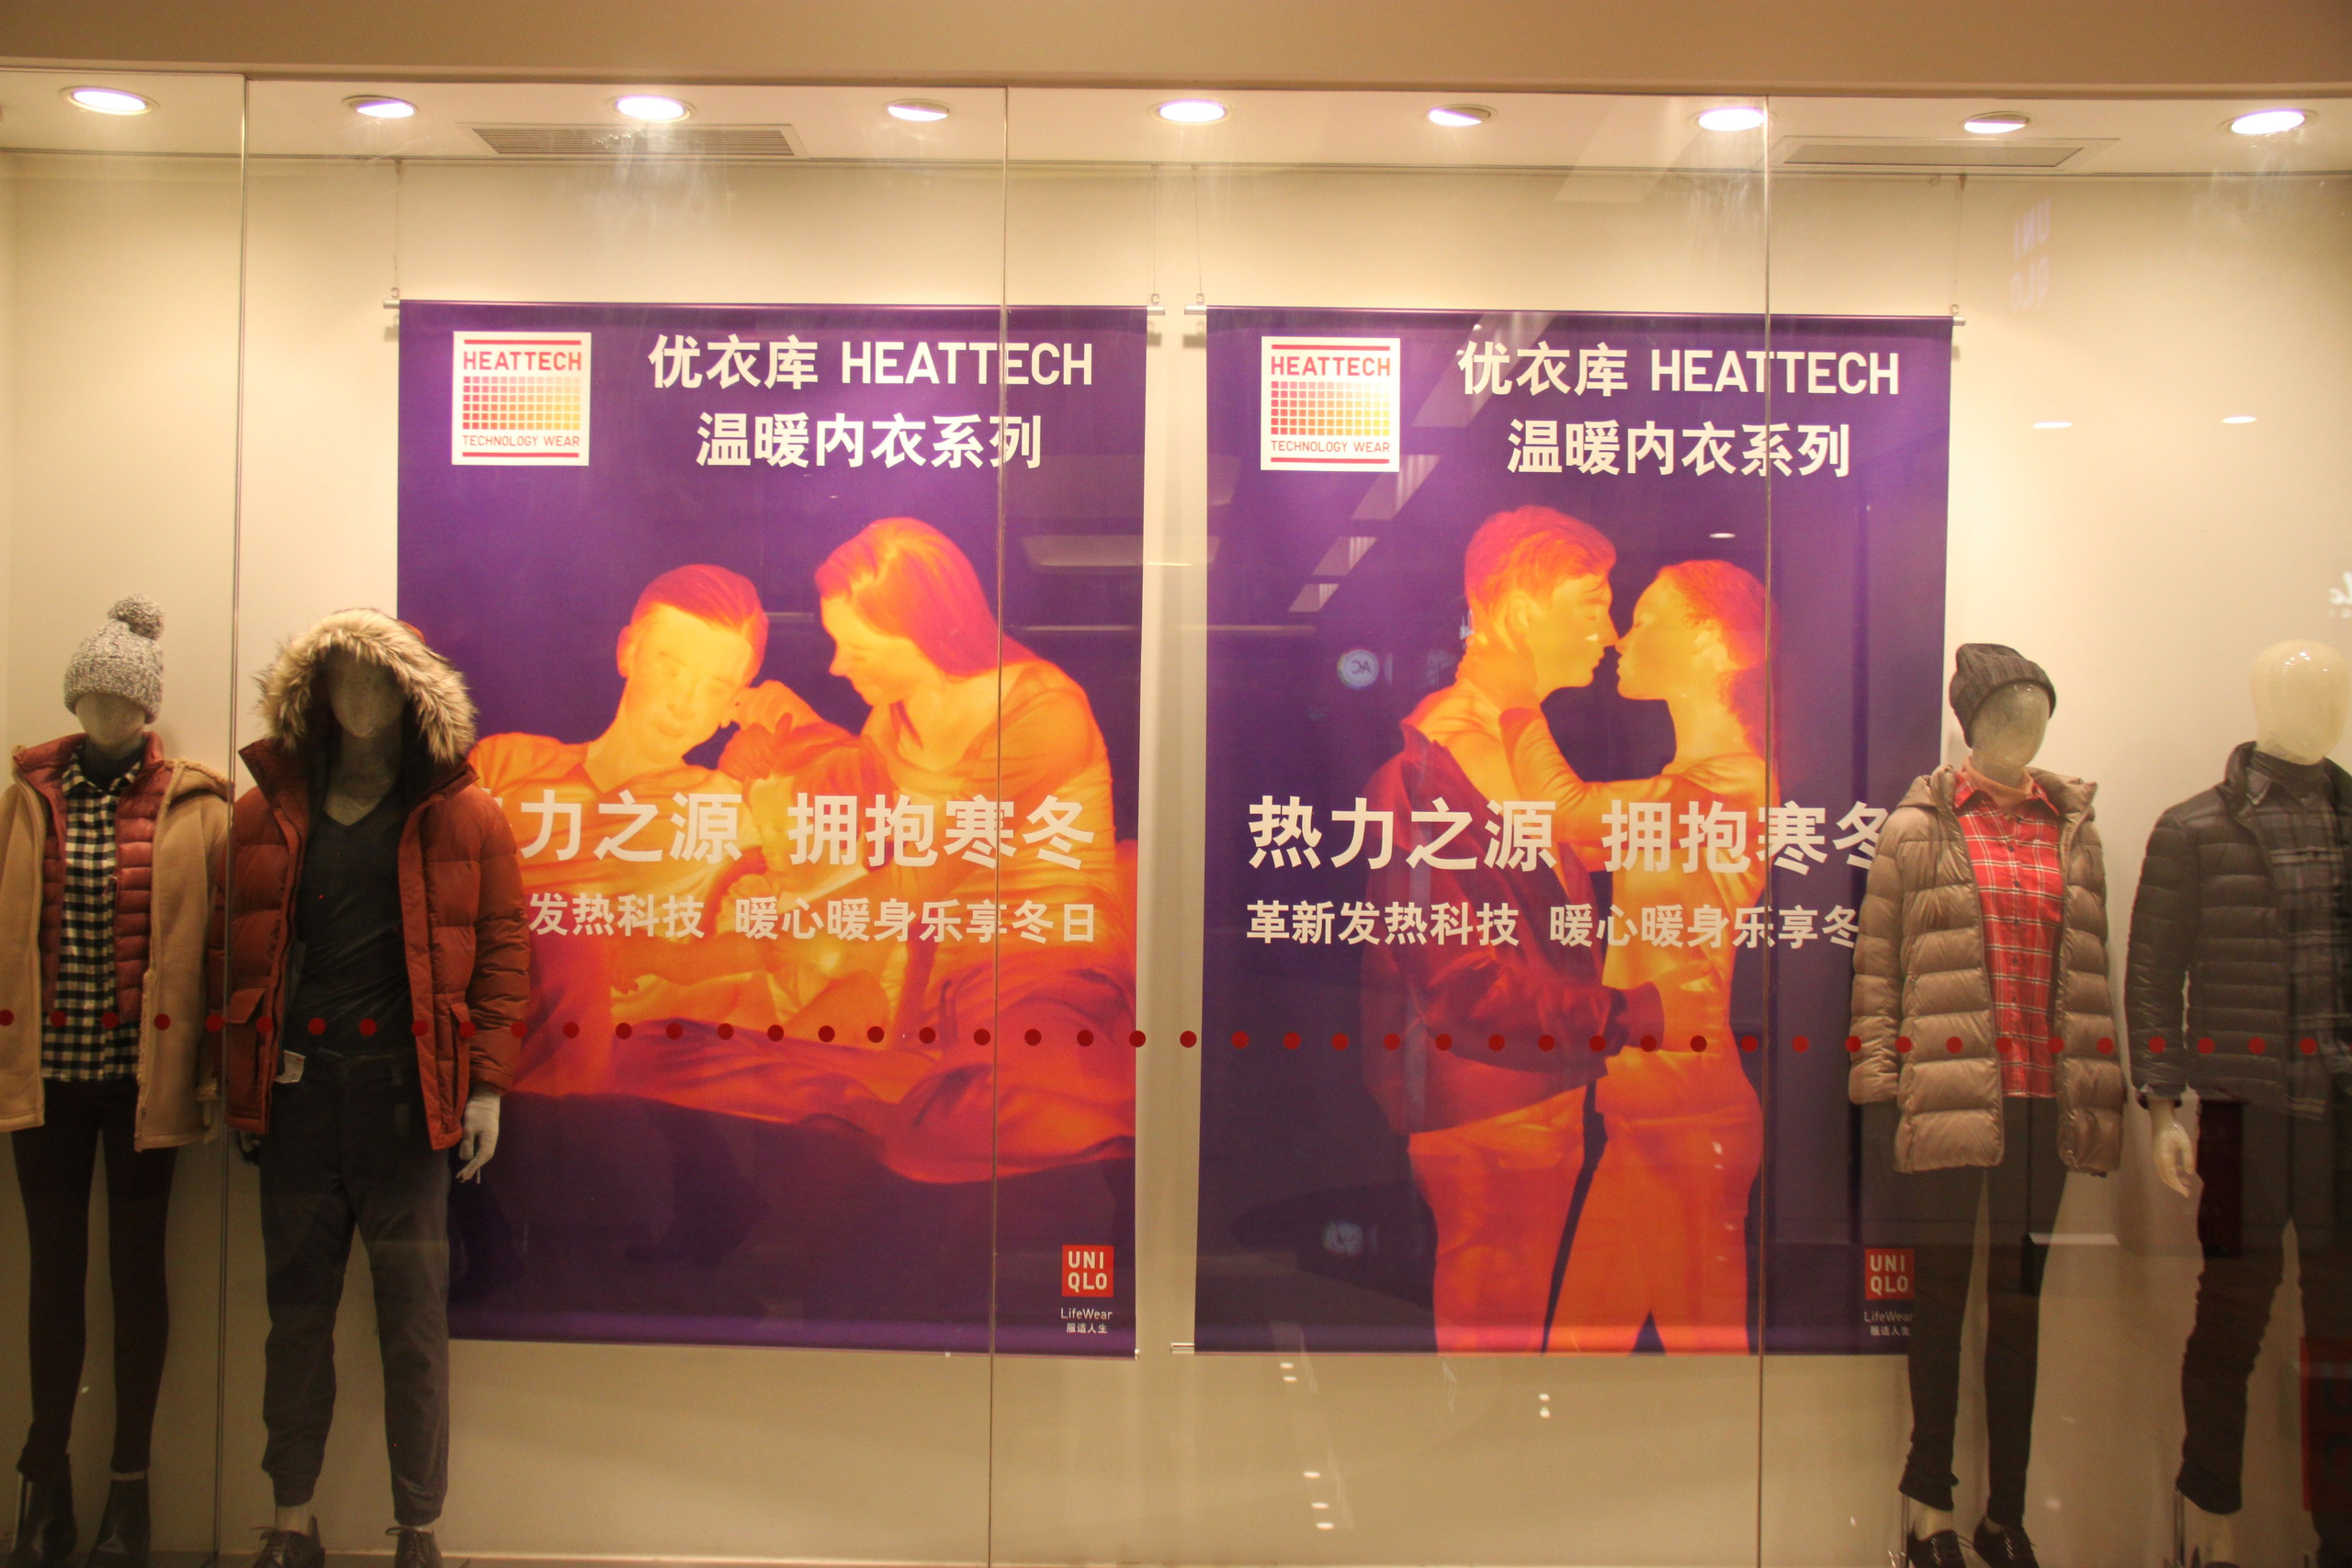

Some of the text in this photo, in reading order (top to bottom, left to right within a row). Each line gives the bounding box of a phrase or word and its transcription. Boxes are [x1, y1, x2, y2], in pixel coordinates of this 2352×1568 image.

[463, 351, 582, 371] HEATTECH
[649, 333, 1092, 390] 优衣库 HEATTECH
[1271, 355, 1390, 377] HEATTECH
[1457, 339, 1899, 397] 优衣库 HEATTECH
[462, 434, 580, 447] TECHNOLOGY WEAR
[695, 412, 1042, 470] 温暖内衣系列
[1271, 440, 1390, 453] TECHNOLOGY WEAR
[1508, 419, 1849, 477] 温暖内衣系列
[482, 787, 1095, 871] 力之源 拥抱寒冬
[1248, 795, 1889, 875] 热力之源 拥抱寒冬
[735, 897, 1096, 944] 暖心暖身乐享冬日
[1247, 900, 1519, 947] 革新发热科技
[1069, 1251, 1104, 1269] UNI
[1870, 1255, 1905, 1272] UNI
[1069, 1272, 1108, 1293] QLO
[1870, 1275, 1909, 1296] QLO
[1060, 1307, 1113, 1320] LifeWear
[1066, 1323, 1107, 1334] 服适人生
